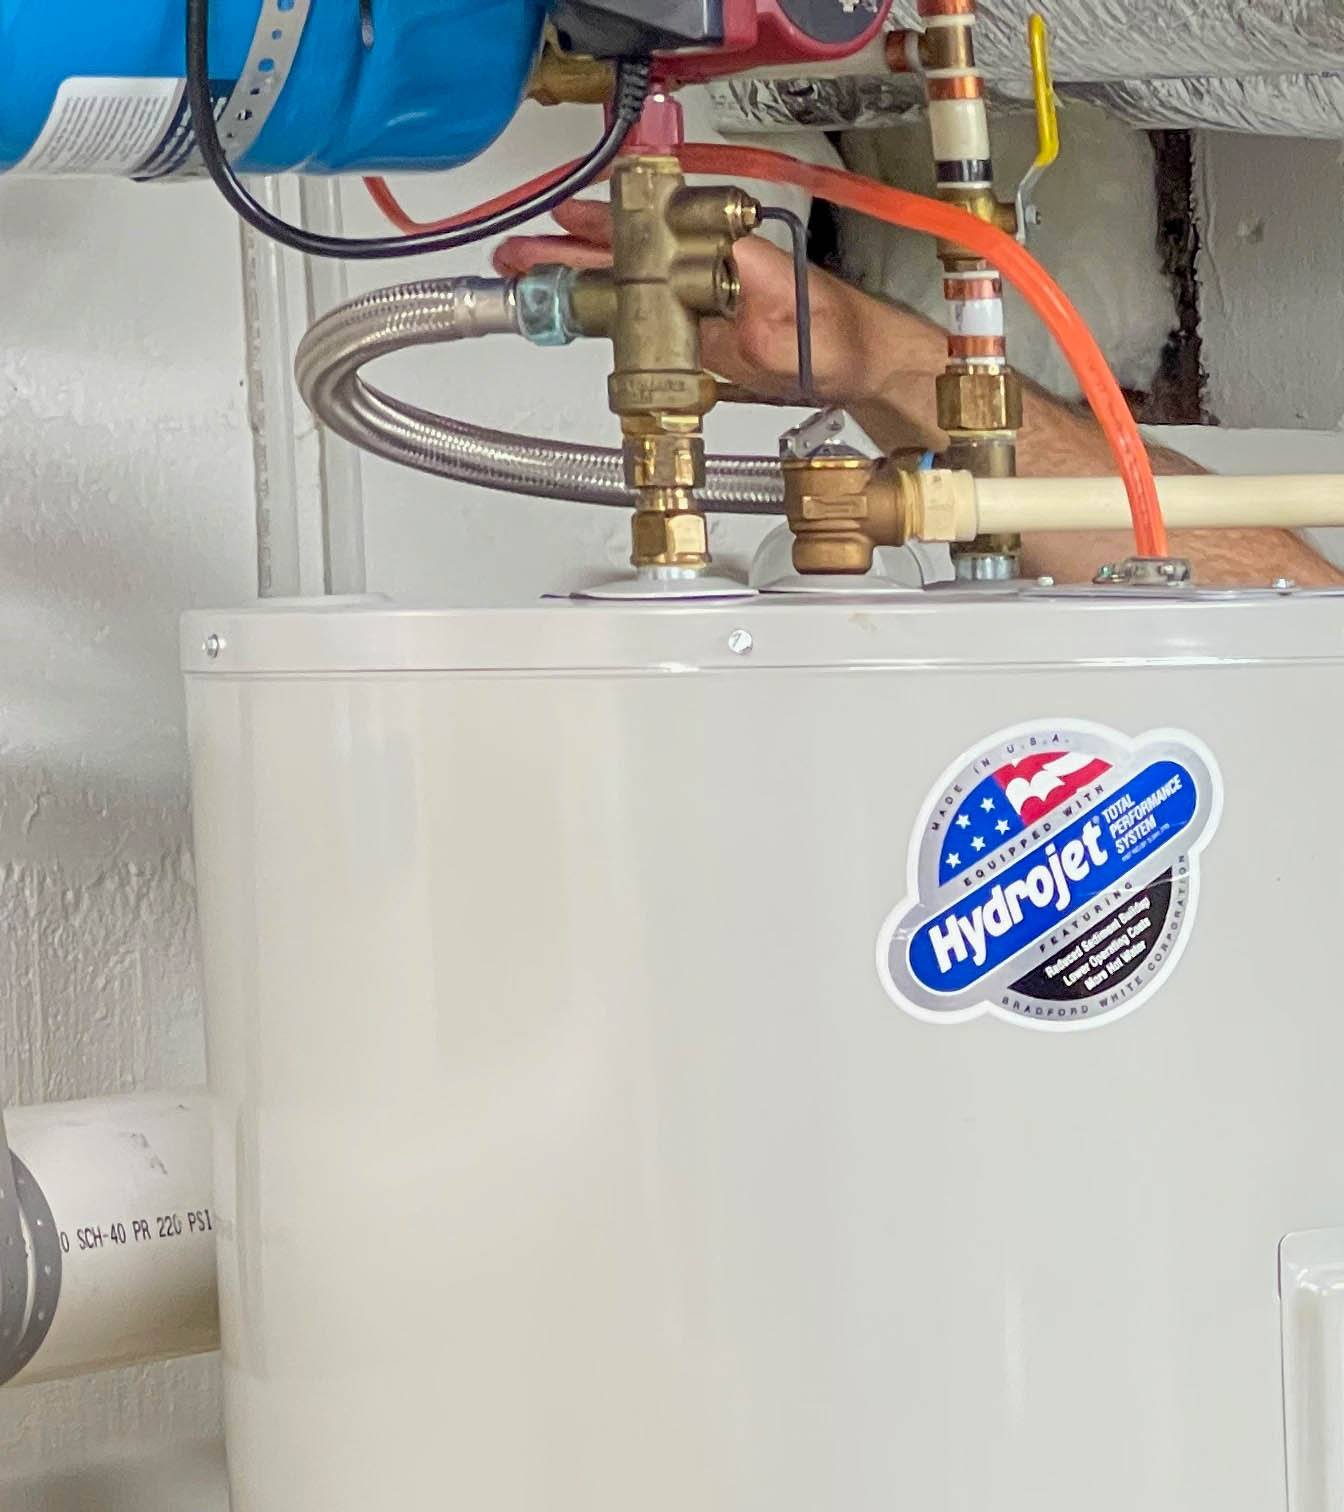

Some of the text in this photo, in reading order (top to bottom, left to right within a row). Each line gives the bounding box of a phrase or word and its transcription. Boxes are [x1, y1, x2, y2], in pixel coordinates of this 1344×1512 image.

[931, 784, 962, 831] MADE
[973, 757, 990, 775] IN
[1101, 793, 1136, 825] TOTAL
[1109, 774, 1183, 839] PERFORMANCE
[963, 784, 1105, 888] EQUIPPED WITH
[1115, 814, 1157, 854] SYSTEM
[928, 820, 1108, 974] Hydrojet
[1040, 882, 1133, 953] FEATURING
[1002, 855, 1187, 1017] BRADFORD WHITE CORPORATION
[1063, 962, 1091, 987] Lower
[1089, 934, 1131, 968] Operating
[1105, 957, 1124, 975] Hot
[77, 1223, 126, 1251] SCH-40
[132, 1220, 152, 1241] PR
[157, 1214, 183, 1239] 220
[187, 1208, 213, 1233] PSI
